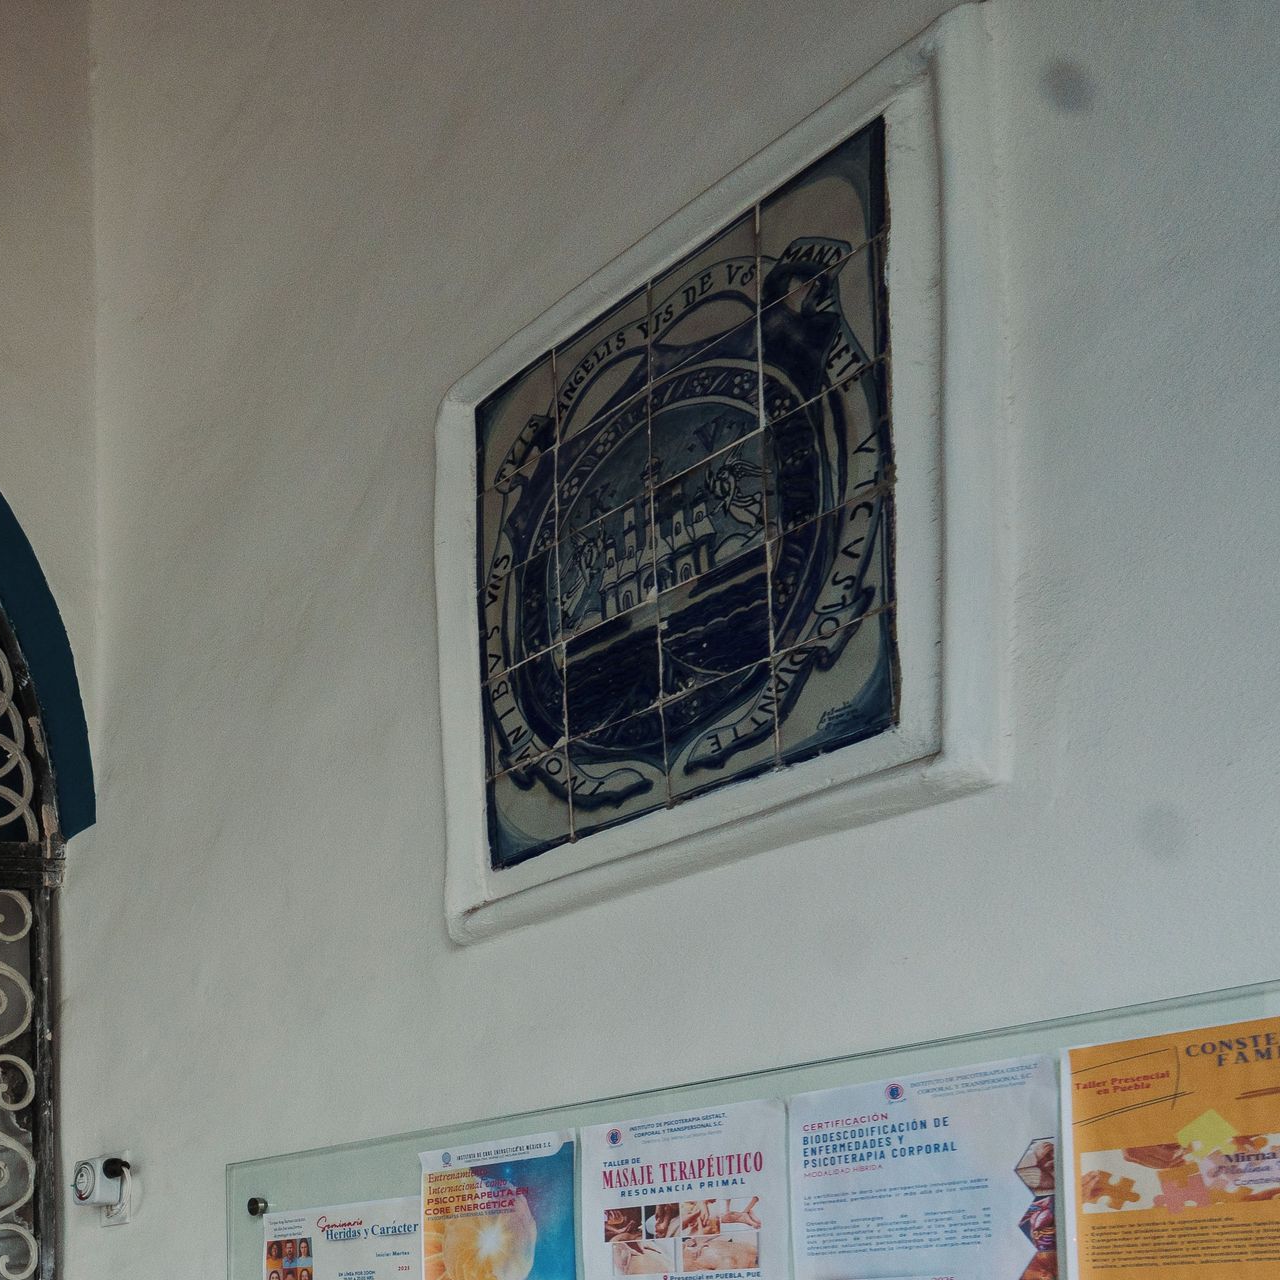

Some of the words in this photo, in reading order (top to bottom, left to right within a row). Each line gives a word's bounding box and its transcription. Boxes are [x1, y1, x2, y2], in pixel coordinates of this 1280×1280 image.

[1075, 1079, 1107, 1091] Taller
[1111, 1070, 1170, 1085] Presencial
[1097, 1088, 1110, 1096] en
[1113, 1082, 1151, 1094] Puebla
[802, 1112, 889, 1132] CERTIFICACIÓN
[802, 1118, 927, 1146] BIODESCODIFICACIÓN
[933, 1116, 949, 1128] DE
[802, 1137, 892, 1157] ENFERMEDADES
[897, 1135, 904, 1145] Y
[803, 1150, 886, 1169] PSICOTERAPIA
[891, 1141, 958, 1159] CORPORAL
[602, 1165, 654, 1190] MASAJE
[659, 1150, 763, 1183] TERAPÉUTICO
[603, 1158, 630, 1168] TALLER
[803, 1167, 852, 1179] MODALIDAD
[427, 1189, 513, 1206] PSICOTERAPEUTA
[515, 1187, 529, 1196] EN
[428, 1180, 483, 1196] Internacional
[620, 1184, 693, 1198] RESONANCIA
[699, 1178, 746, 1189] PRIMAL
[424, 1206, 451, 1216] CORE
[326, 1227, 361, 1241] Heridas
[363, 1228, 370, 1239] y
[371, 1220, 419, 1236] Carácter
